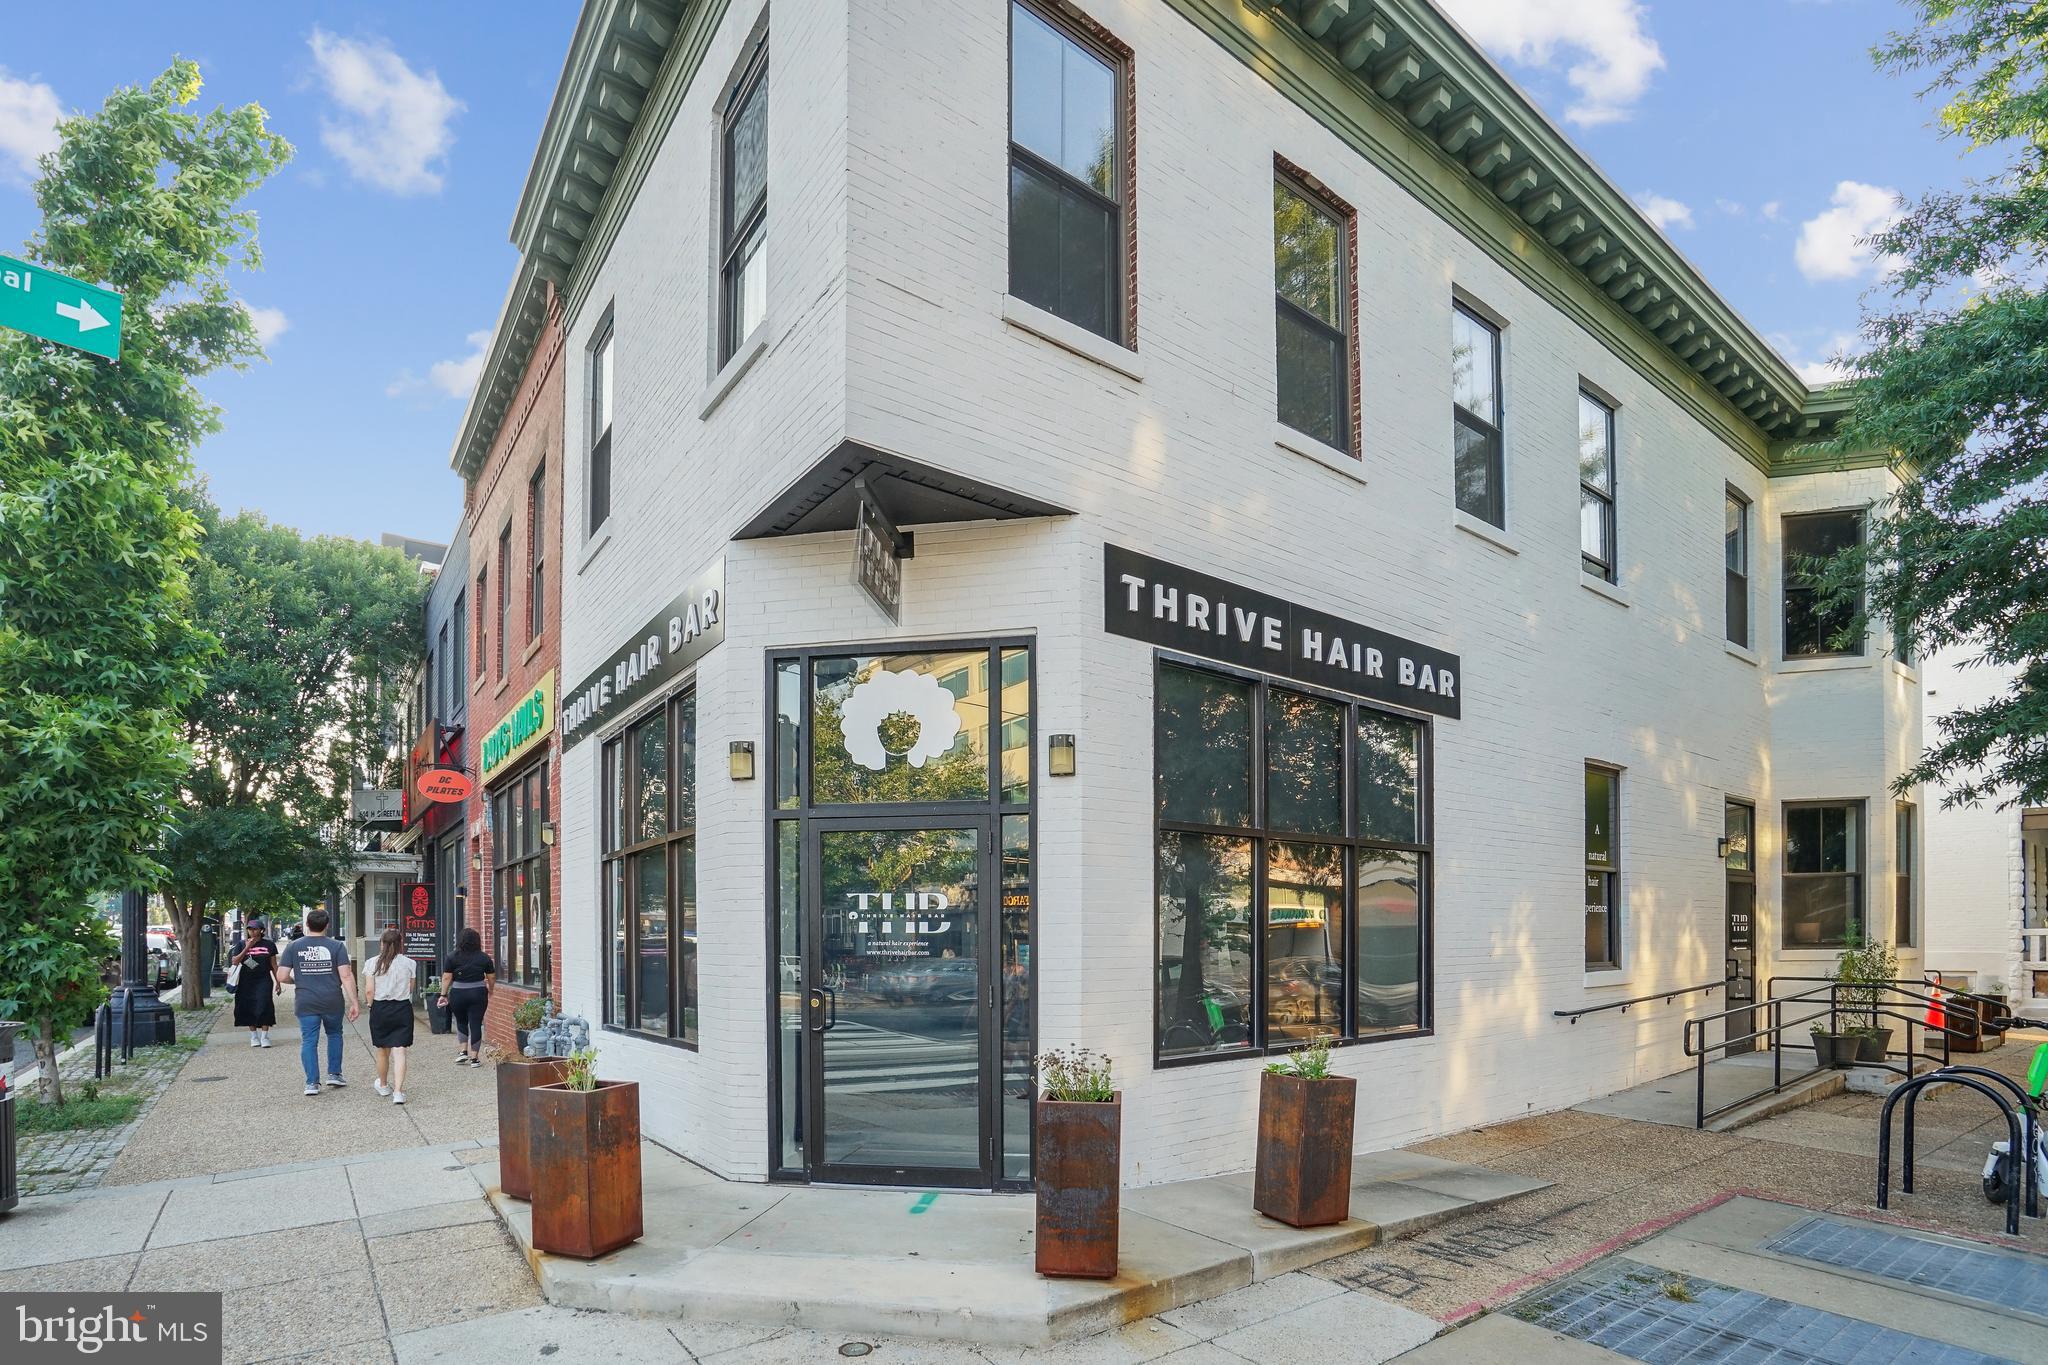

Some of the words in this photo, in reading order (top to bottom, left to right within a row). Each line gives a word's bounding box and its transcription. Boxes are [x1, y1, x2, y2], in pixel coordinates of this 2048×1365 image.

[0, 270, 31, 292] al
[1120, 573, 1282, 651] THRIVE
[1301, 628, 1384, 679] HAIR
[1397, 656, 1455, 698] BAR
[562, 675, 612, 735] THRIVE
[615, 635, 662, 695] HAIR
[668, 587, 719, 655] BAR
[438, 776, 452, 784] DC
[426, 785, 464, 796] PILATES
[1594, 824, 1600, 835] A
[1588, 850, 1607, 861] natural
[1587, 875, 1599, 887] hair
